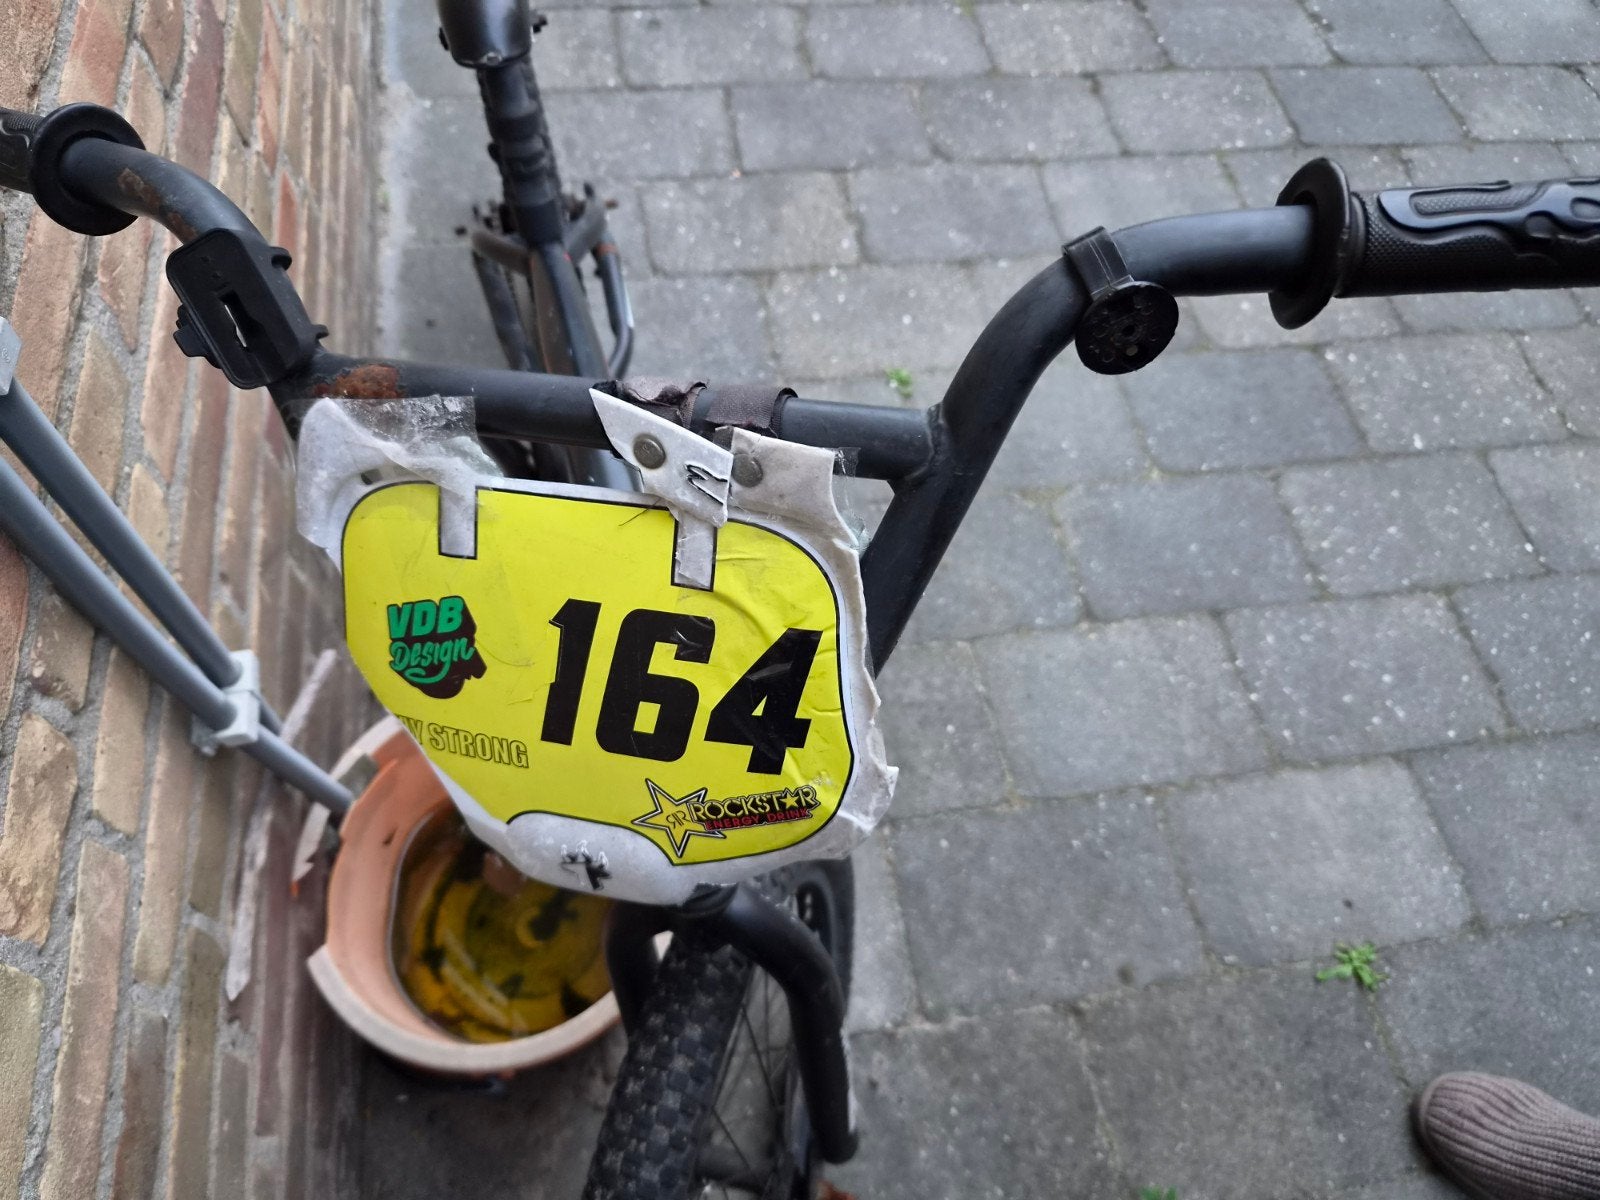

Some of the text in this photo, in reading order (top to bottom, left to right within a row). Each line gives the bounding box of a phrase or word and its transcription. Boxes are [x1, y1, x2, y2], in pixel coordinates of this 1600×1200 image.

[387, 595, 464, 639] VDB
[389, 636, 475, 684] Design
[541, 598, 823, 775] 164
[428, 722, 529, 769] STRONG
[705, 808, 809, 831] ENERGY DRINK
